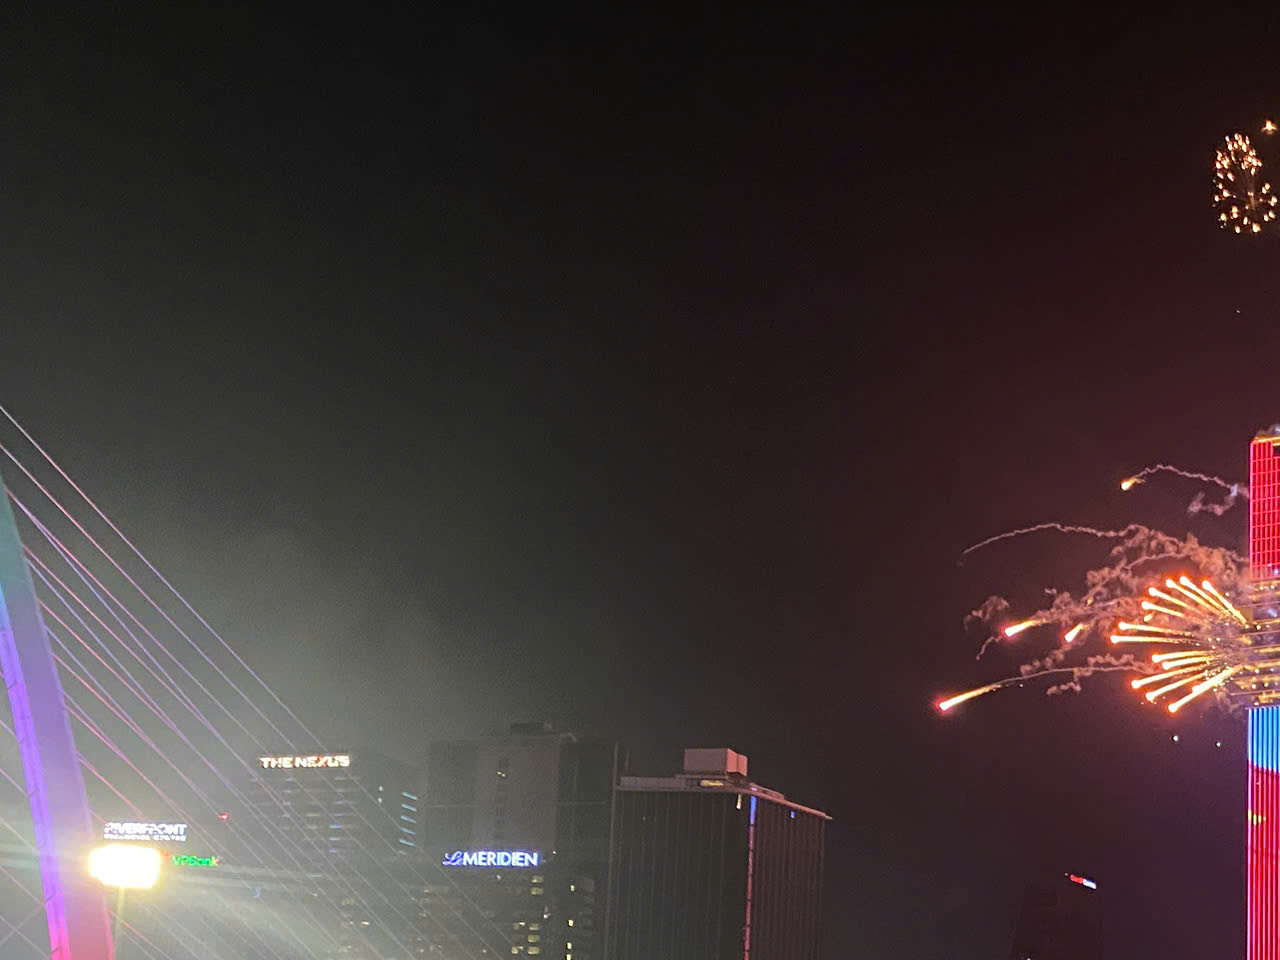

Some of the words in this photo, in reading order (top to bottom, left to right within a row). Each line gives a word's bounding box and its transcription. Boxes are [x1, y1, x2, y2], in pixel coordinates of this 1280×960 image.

[260, 756, 293, 769] THE
[295, 755, 350, 768] NEXUS
[463, 851, 539, 867] MERIDIEN
